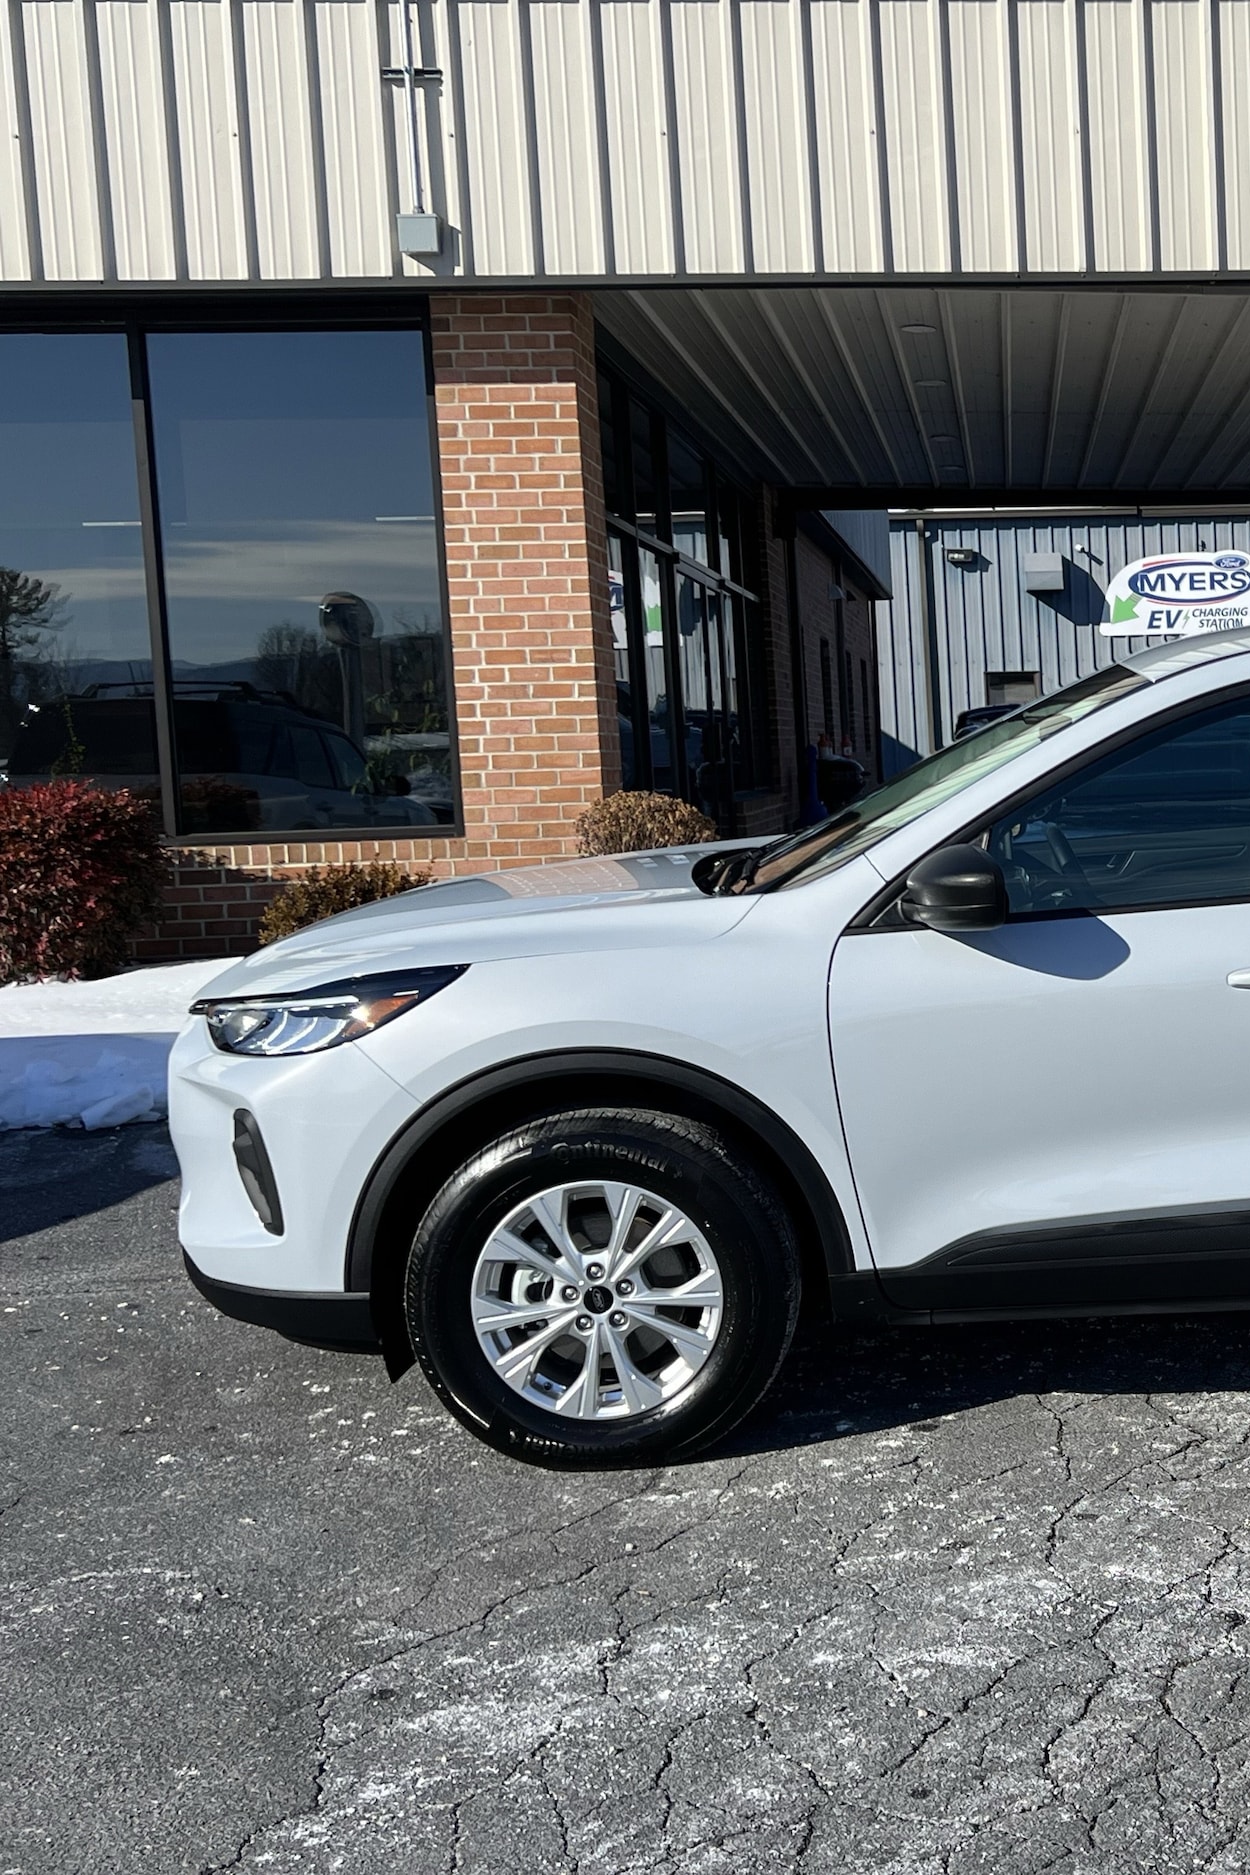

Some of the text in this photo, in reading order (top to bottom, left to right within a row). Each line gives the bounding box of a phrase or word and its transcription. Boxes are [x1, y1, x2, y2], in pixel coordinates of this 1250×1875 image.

[1219, 558, 1242, 568] Ford
[1140, 572, 1248, 592] MYERS
[1192, 607, 1248, 618] CHARGING
[1147, 609, 1183, 629] EV
[1199, 618, 1244, 629] STATION
